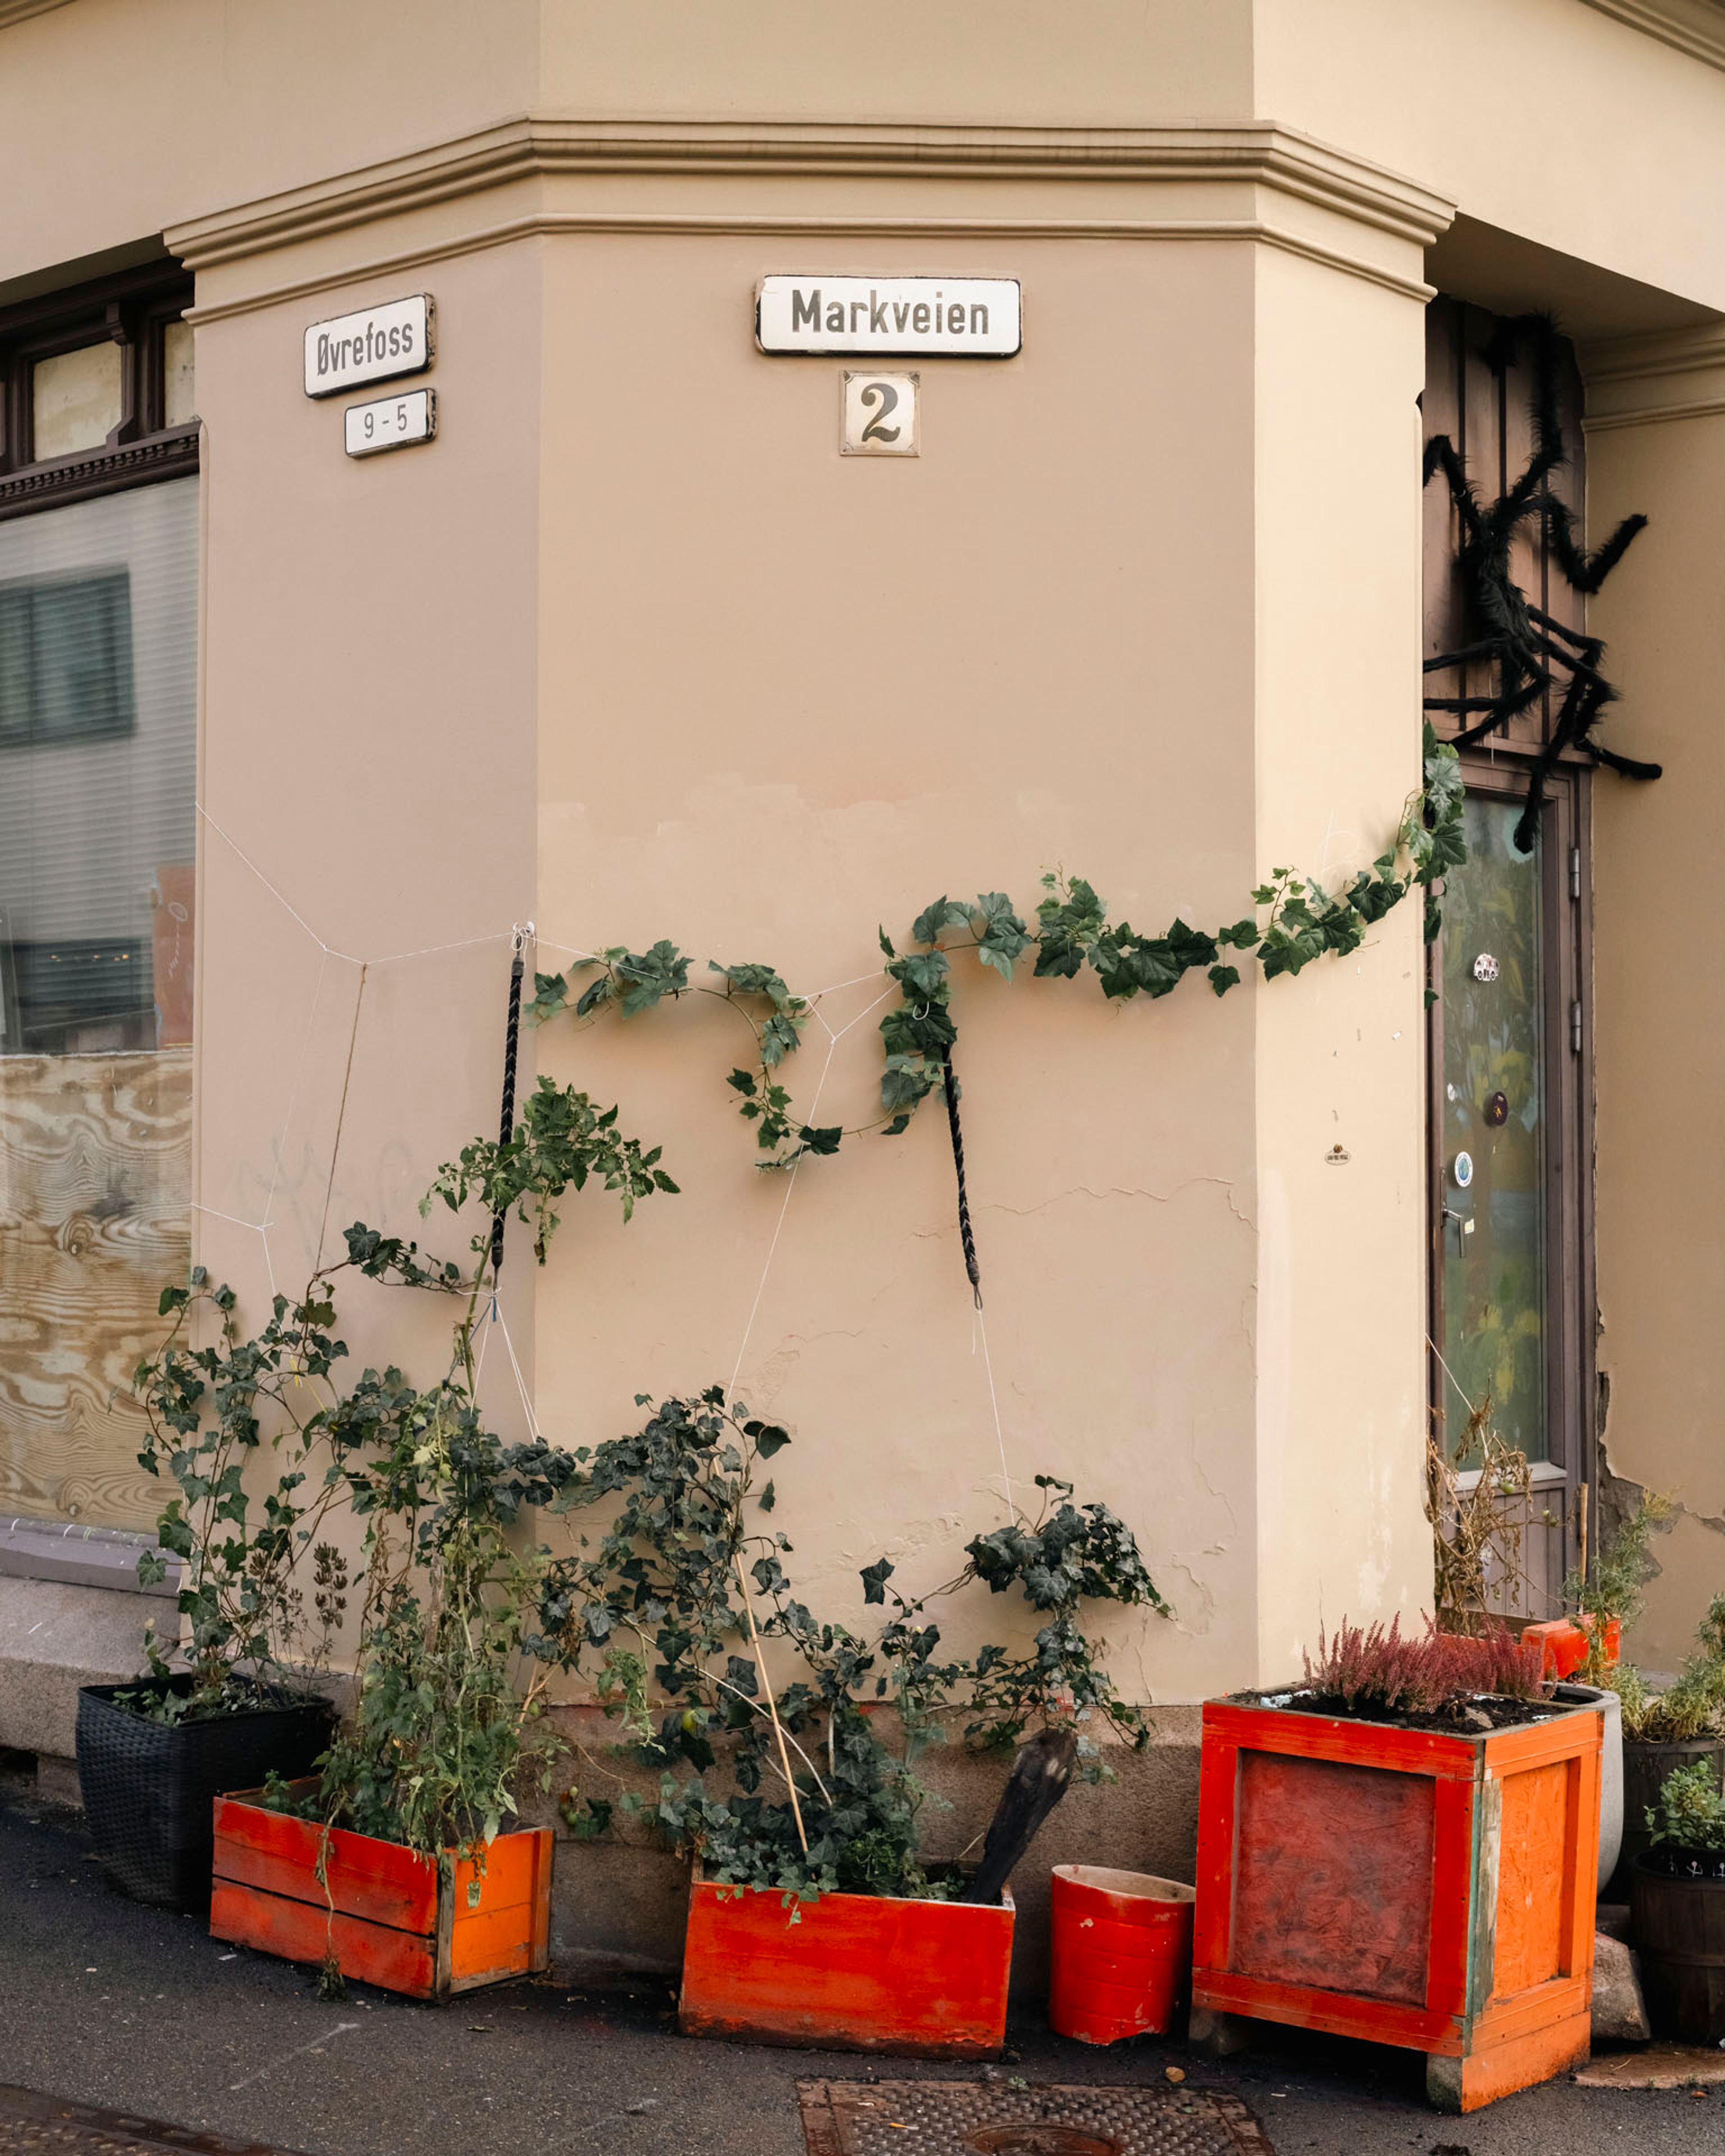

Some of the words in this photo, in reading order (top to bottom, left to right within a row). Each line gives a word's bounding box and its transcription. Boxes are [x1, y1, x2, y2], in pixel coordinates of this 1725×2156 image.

[792, 289, 989, 334] Markveien
[317, 322, 413, 376] Øvrefoss
[861, 383, 901, 442] 2
